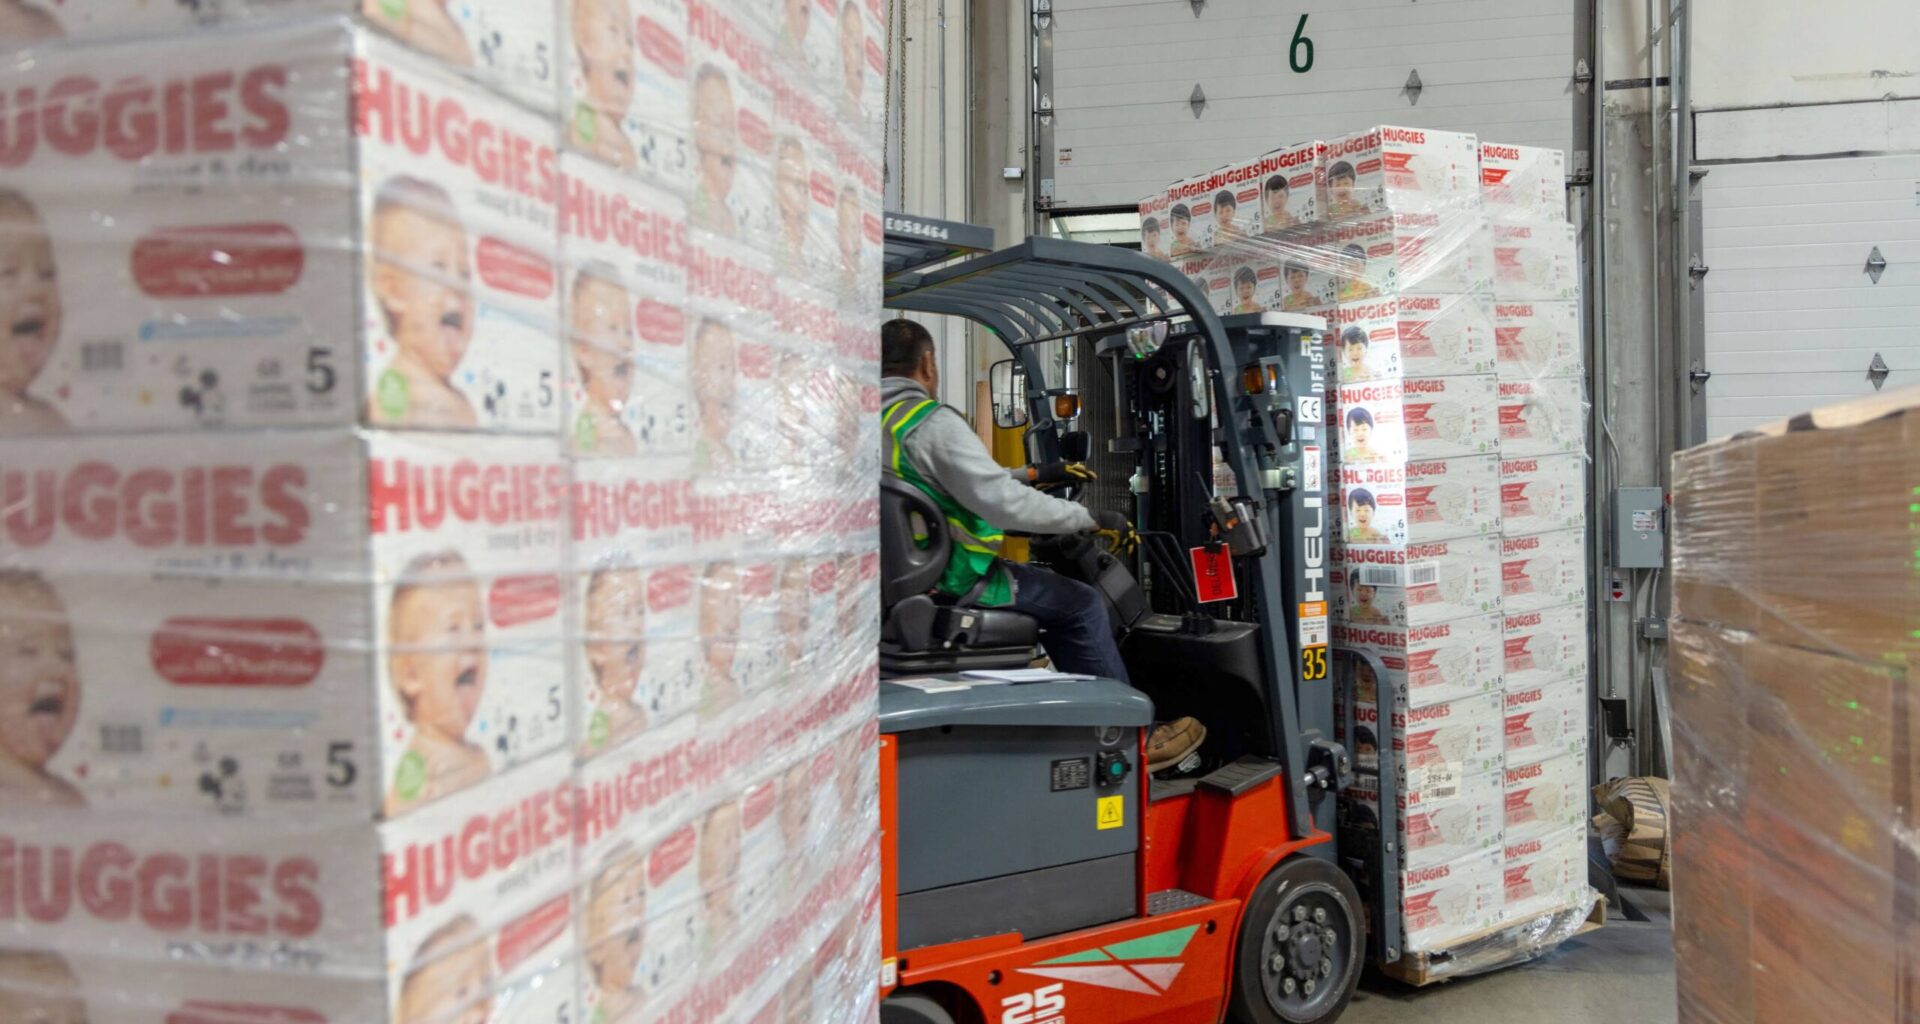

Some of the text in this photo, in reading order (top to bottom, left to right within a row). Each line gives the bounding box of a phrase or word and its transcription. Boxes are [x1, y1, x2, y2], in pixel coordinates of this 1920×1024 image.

[1288, 14, 1315, 74] 6
[535, 42, 549, 80] 5
[0, 65, 290, 169] UGGIES
[346, 56, 556, 204] HUGGIES
[1382, 127, 1426, 145] HUGGIES
[1326, 131, 1382, 160] HUGGIES
[1482, 144, 1520, 161] HUGGIES
[1260, 147, 1315, 174] HUGGIES
[1211, 163, 1260, 188] HUGGIES
[1167, 179, 1214, 203] HUGGIES
[1378, 184, 1384, 194] 6
[1308, 198, 1314, 207] 6
[559, 171, 689, 268] HUGGIES
[1254, 211, 1260, 221] 6
[1207, 224, 1213, 233] 6
[1336, 215, 1395, 242] HUGGIES
[1388, 267, 1395, 277] 6
[1328, 279, 1334, 288] 6
[1274, 290, 1280, 299] 6
[1225, 299, 1231, 308] 6
[1399, 296, 1441, 312] HUGGIES
[1496, 304, 1533, 318] HUGGIES
[1338, 302, 1397, 324] HUGGIES
[1329, 358, 1335, 368] 6
[1391, 352, 1397, 362] 6
[1489, 359, 1495, 368] 6
[305, 346, 336, 394] 5
[538, 370, 553, 407] 5
[1342, 384, 1403, 404] HUGGIES
[1403, 379, 1445, 394] HUGGIES
[1332, 438, 1338, 448] 6
[1493, 438, 1498, 448] 6
[1405, 461, 1447, 477] HUGGIES
[1502, 459, 1538, 474] HUGGIES
[3, 460, 311, 548] UGGIES
[369, 457, 564, 535] HUGGIES
[571, 477, 695, 542] HUGGIES
[1335, 518, 1341, 528] 6
[1398, 519, 1404, 529] 6
[1495, 517, 1500, 527] 6
[1303, 497, 1324, 602] HELI
[1407, 543, 1448, 559] HUGGIES
[1503, 536, 1539, 553] HUGGIES
[1346, 548, 1405, 565] HUGGIES
[1579, 587, 1585, 597] 6
[1338, 596, 1344, 606] 6
[1398, 601, 1404, 611] 6
[1496, 596, 1501, 606] 6
[1505, 612, 1541, 630] HUGGIES
[1349, 625, 1406, 646] HUGGIES
[1408, 624, 1450, 641] HUGGIES
[1303, 648, 1327, 681] 35
[1400, 683, 1406, 693] 6
[1497, 675, 1502, 685] 6
[547, 685, 561, 721] 5
[1506, 688, 1542, 707] HUGGIES
[1408, 704, 1450, 723] HUGGIES
[326, 742, 356, 788] 5
[1497, 754, 1502, 763] 6
[1399, 764, 1405, 774] 6
[1506, 763, 1542, 783] HUGGIES
[573, 752, 687, 847] HUGGIES
[1497, 832, 1502, 841] 6
[379, 779, 574, 929] HUGGIES
[1504, 839, 1542, 860] HUGGIES
[1407, 864, 1450, 886] HUGGIES
[1001, 982, 1066, 1024] 25
